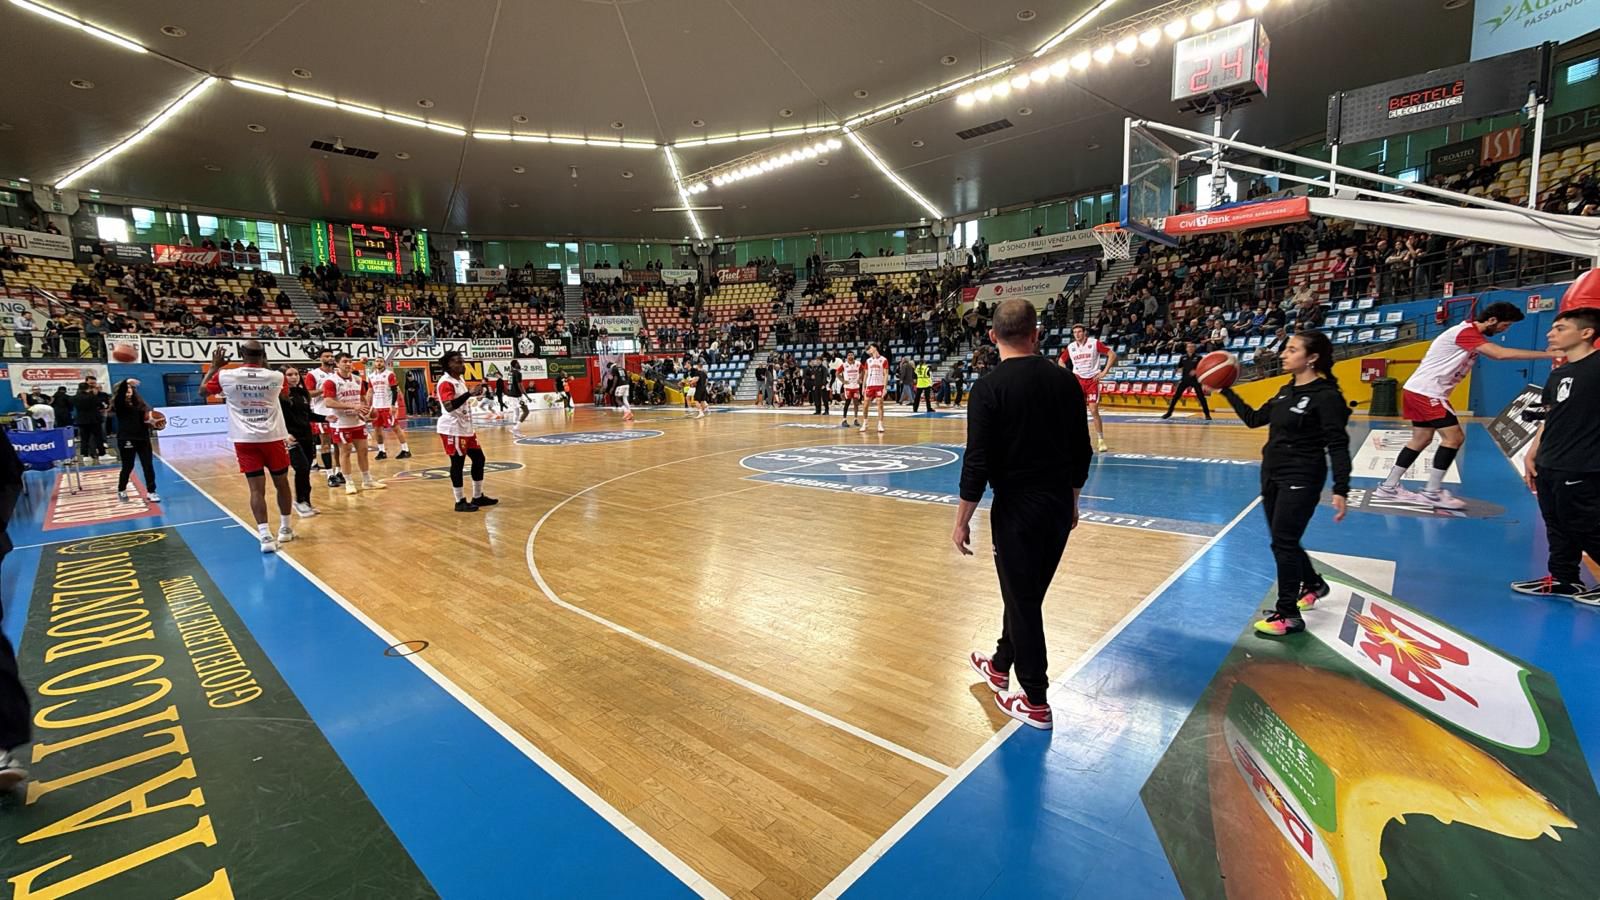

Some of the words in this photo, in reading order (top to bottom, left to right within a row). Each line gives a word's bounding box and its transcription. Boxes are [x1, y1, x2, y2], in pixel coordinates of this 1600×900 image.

[1189, 47, 1243, 92] 24
[1388, 96, 1463, 118] ELECTRONICS
[1006, 243, 1027, 252] SONO
[1027, 240, 1047, 249] FRIULI
[1047, 234, 1077, 245] VENEZIA
[717, 268, 741, 283] Fuel
[1005, 282, 1051, 294] idealservice
[472, 351, 513, 359] GUARDIA
[774, 476, 852, 491] Allianz
[888, 489, 954, 504] Bank
[159, 575, 206, 608] UDINE
[44, 551, 155, 664] RONZONI
[176, 614, 263, 709] GIOIELLERIE
